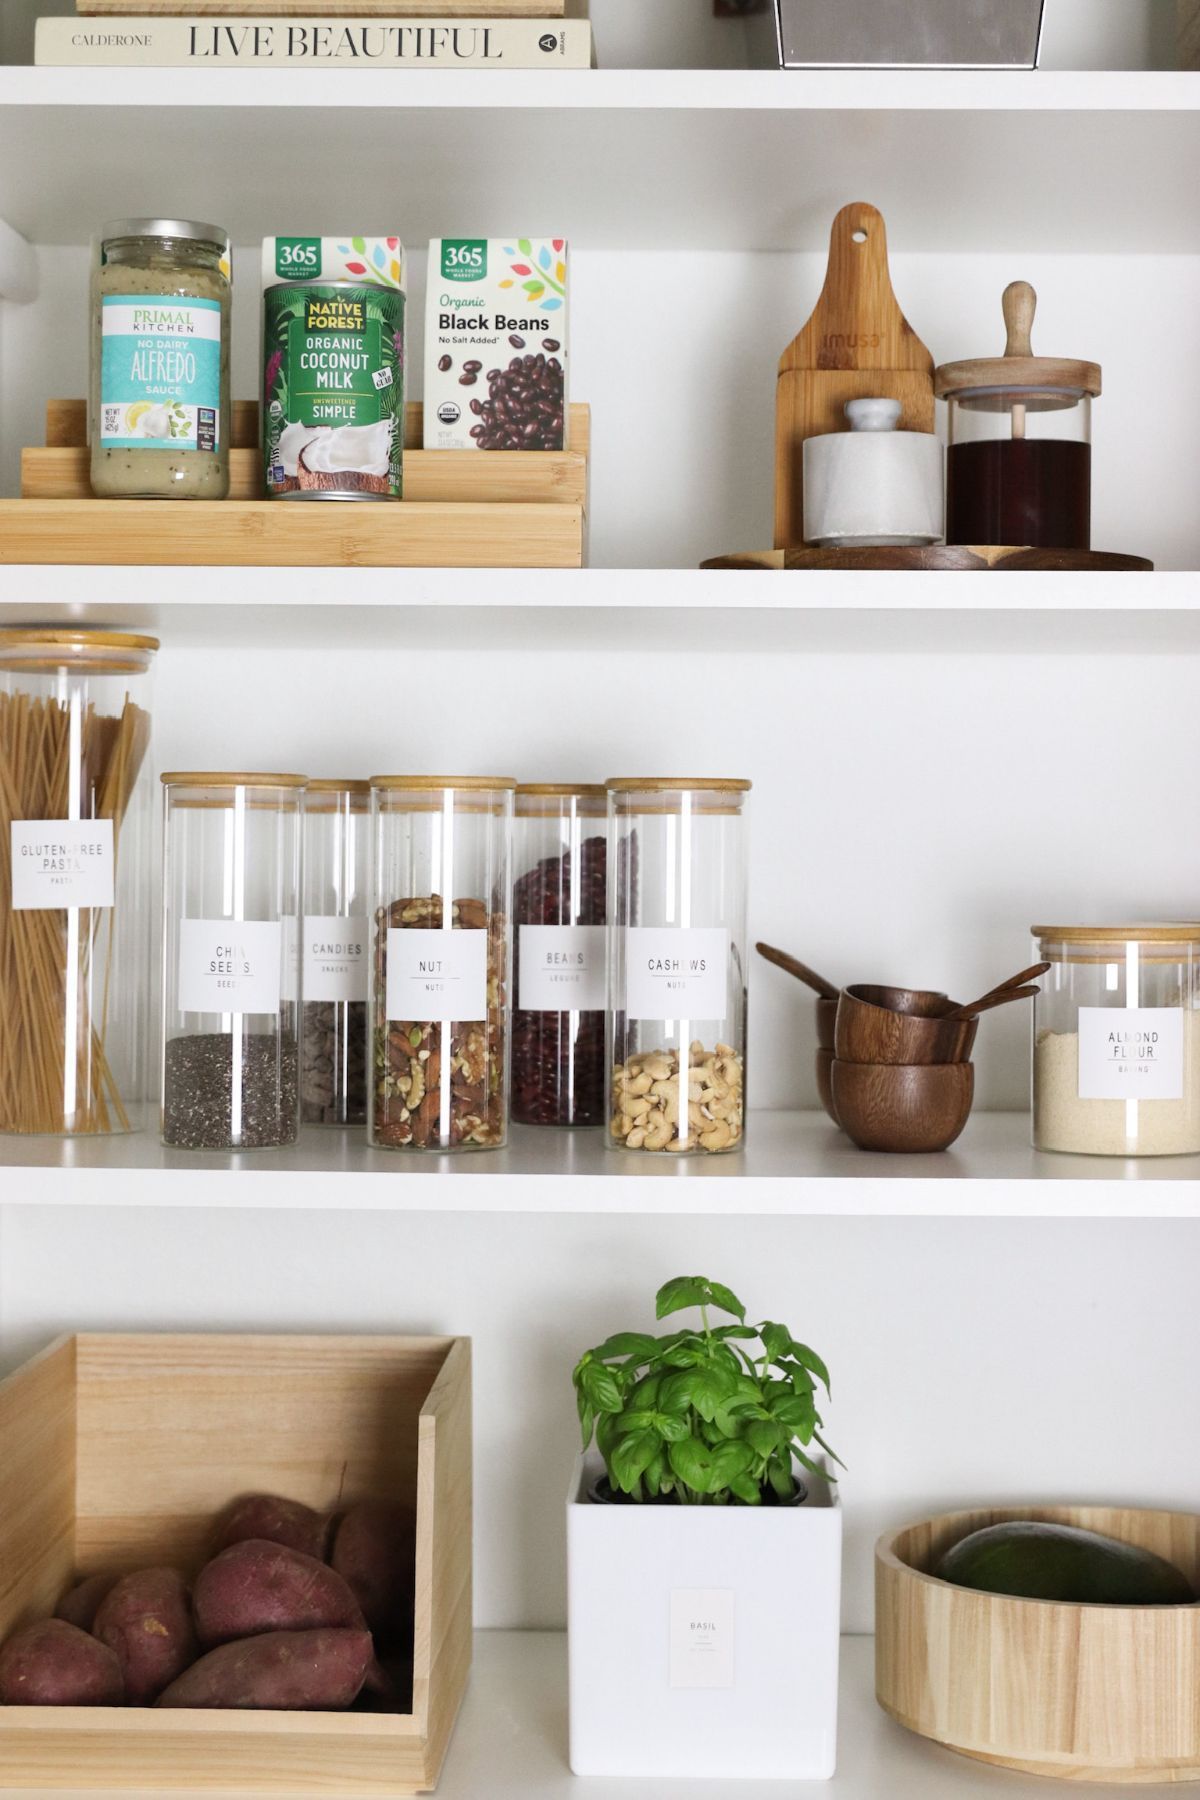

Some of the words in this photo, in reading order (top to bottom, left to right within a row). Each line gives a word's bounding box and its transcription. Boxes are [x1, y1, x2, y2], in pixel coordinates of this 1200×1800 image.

[71, 34, 153, 47] CALDERONE
[187, 26, 274, 57] LIVE
[286, 26, 503, 58] BEAUTIFUL
[280, 244, 317, 265] 365
[445, 245, 482, 267] 365
[309, 302, 363, 316] NATIVE
[439, 293, 486, 311] Organic
[133, 310, 194, 325] PRIMAL
[308, 316, 364, 330] FOREST
[439, 314, 490, 330] Black
[494, 314, 550, 331] Beans
[133, 323, 195, 333] KITCHEN
[137, 340, 154, 349] NO
[156, 340, 190, 350] DAIRY
[306, 337, 363, 351] ORGANIC
[438, 336, 451, 344] No
[452, 336, 468, 344] Salt
[131, 350, 196, 384] ALFREDO
[300, 353, 370, 371] COCONUT
[316, 371, 354, 389] MILK
[145, 385, 183, 396] SAUCE
[312, 405, 357, 419] SIMPLE
[43, 858, 81, 870] PASTA
[312, 943, 362, 955] CANDIES
[209, 960, 251, 974] SEES
[647, 958, 706, 971] CASHWS
[1113, 1045, 1154, 1058] FLUR
[690, 1622, 716, 1631] BASIL
